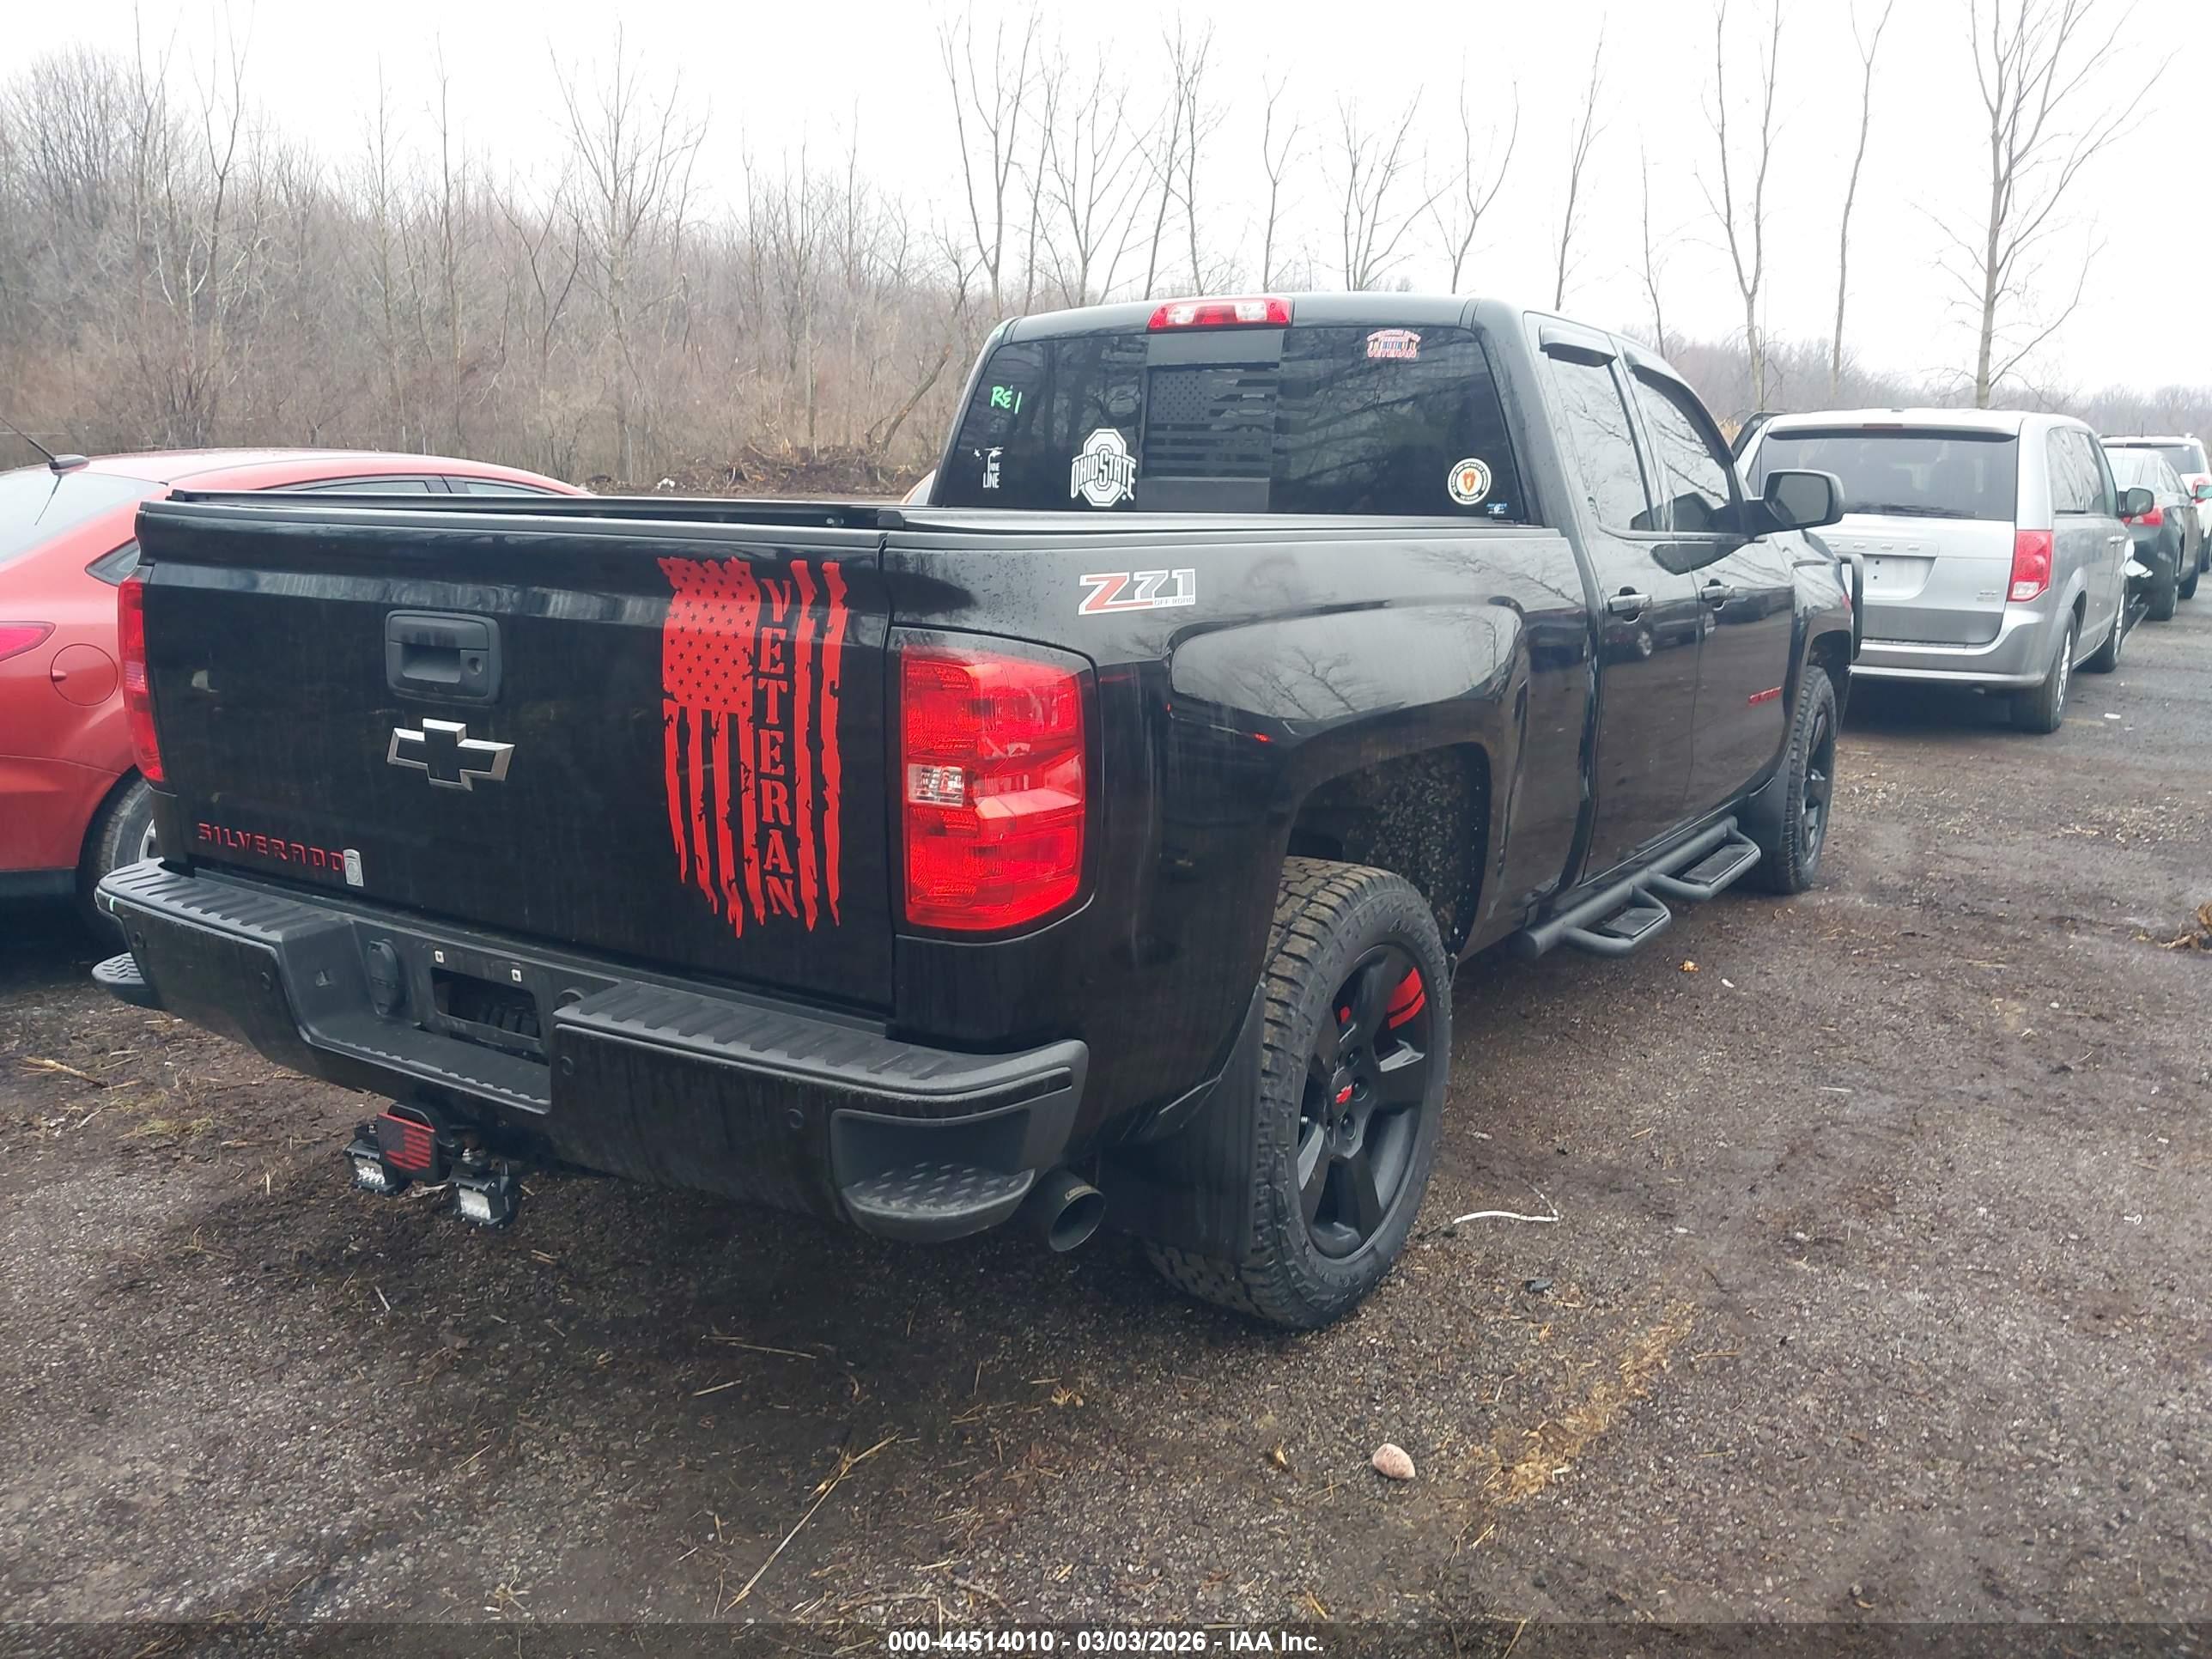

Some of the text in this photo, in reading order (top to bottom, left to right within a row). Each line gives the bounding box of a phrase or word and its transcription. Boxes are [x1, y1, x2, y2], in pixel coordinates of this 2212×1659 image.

[1078, 568, 1196, 616] Z71
[757, 578, 799, 918] VETERAN
[198, 822, 345, 872] SILVERADO
